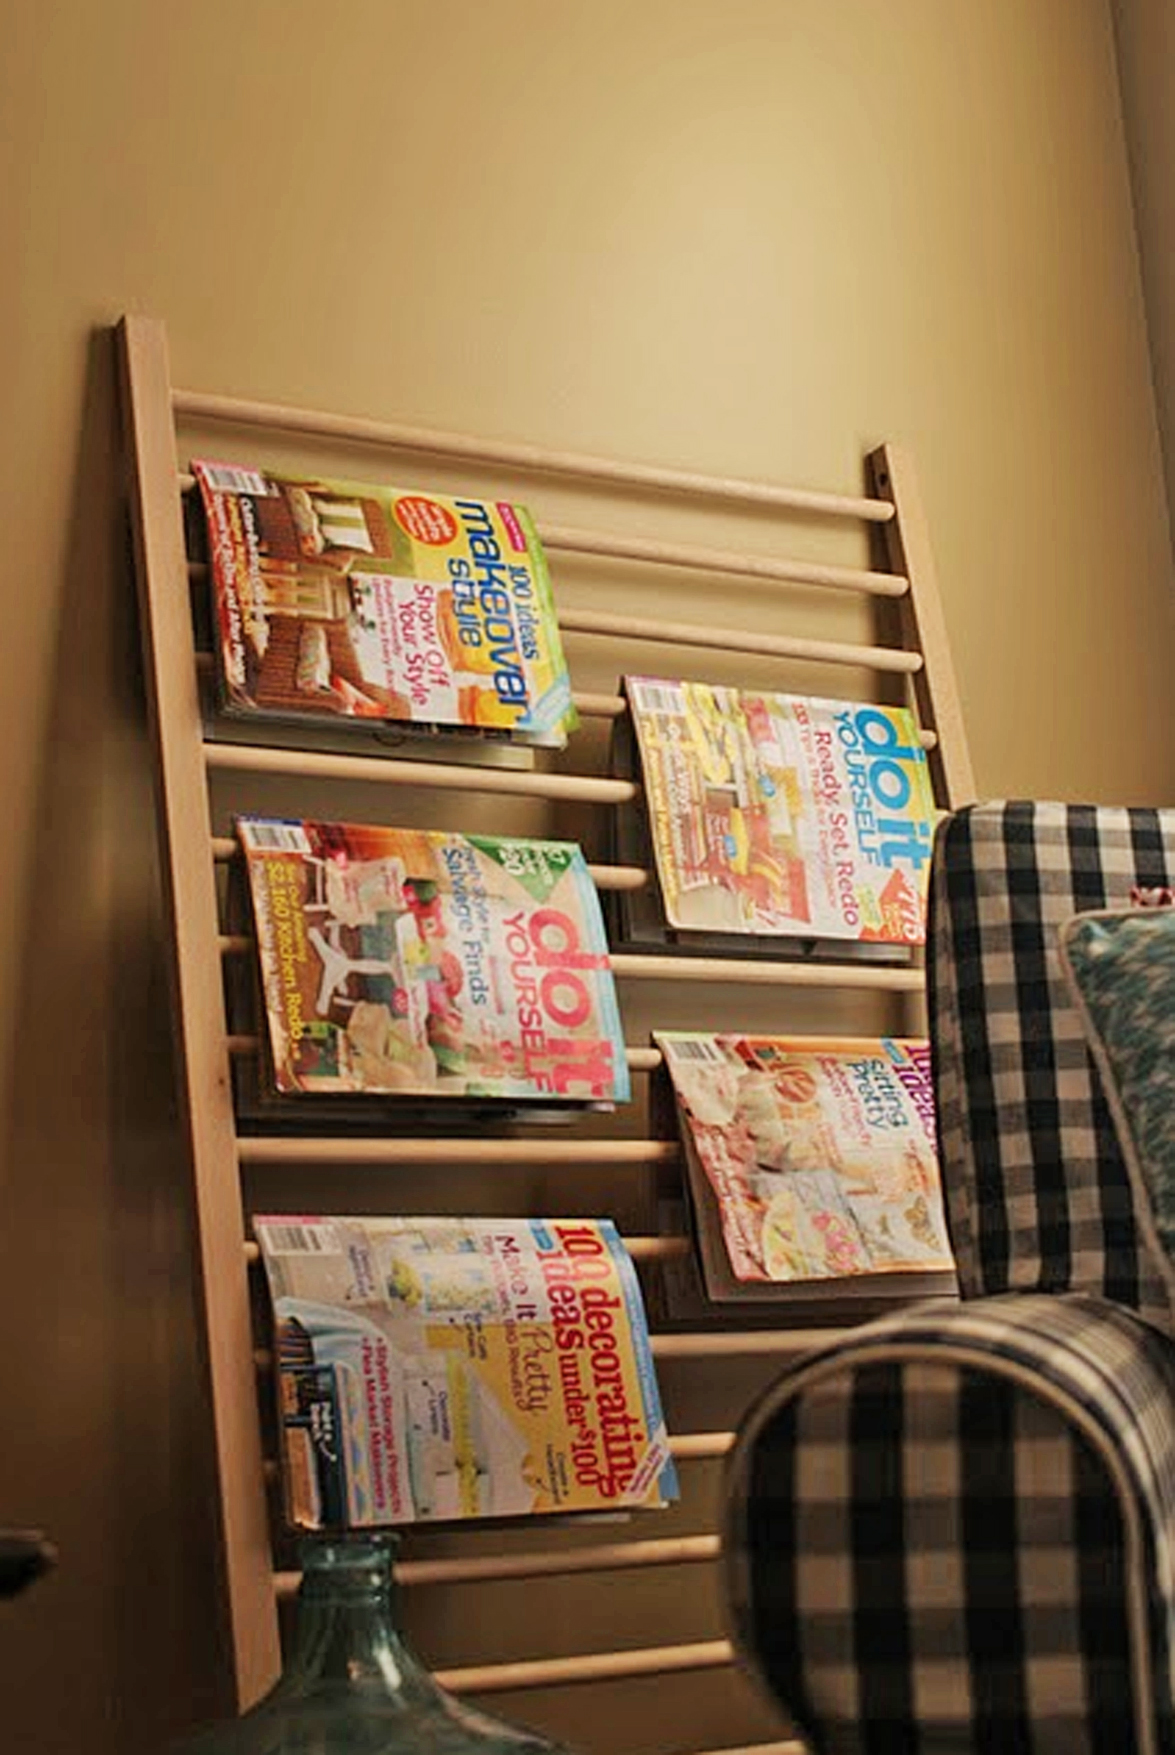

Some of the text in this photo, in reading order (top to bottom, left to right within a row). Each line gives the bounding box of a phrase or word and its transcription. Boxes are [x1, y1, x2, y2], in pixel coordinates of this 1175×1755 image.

[448, 558, 482, 647] style
[455, 502, 532, 726] makeover
[509, 565, 532, 597] 100
[514, 603, 540, 660] ideas
[397, 602, 429, 705] Your Style
[414, 584, 449, 687] Show Off
[833, 711, 881, 866] YOURSELF
[854, 709, 932, 870] do it
[443, 848, 488, 1005] Salvage Finds
[835, 861, 859, 926] Redo
[278, 922, 297, 987] Kitchen
[503, 911, 553, 1092] YOURSELF
[528, 909, 611, 1028] do
[536, 1250, 584, 1351] ideas
[554, 1226, 611, 1280] 100
[495, 1236, 553, 1415] Make It Pretty
[558, 1354, 589, 1429] under
[580, 1288, 644, 1498] decorating
[570, 1430, 599, 1486] $100
